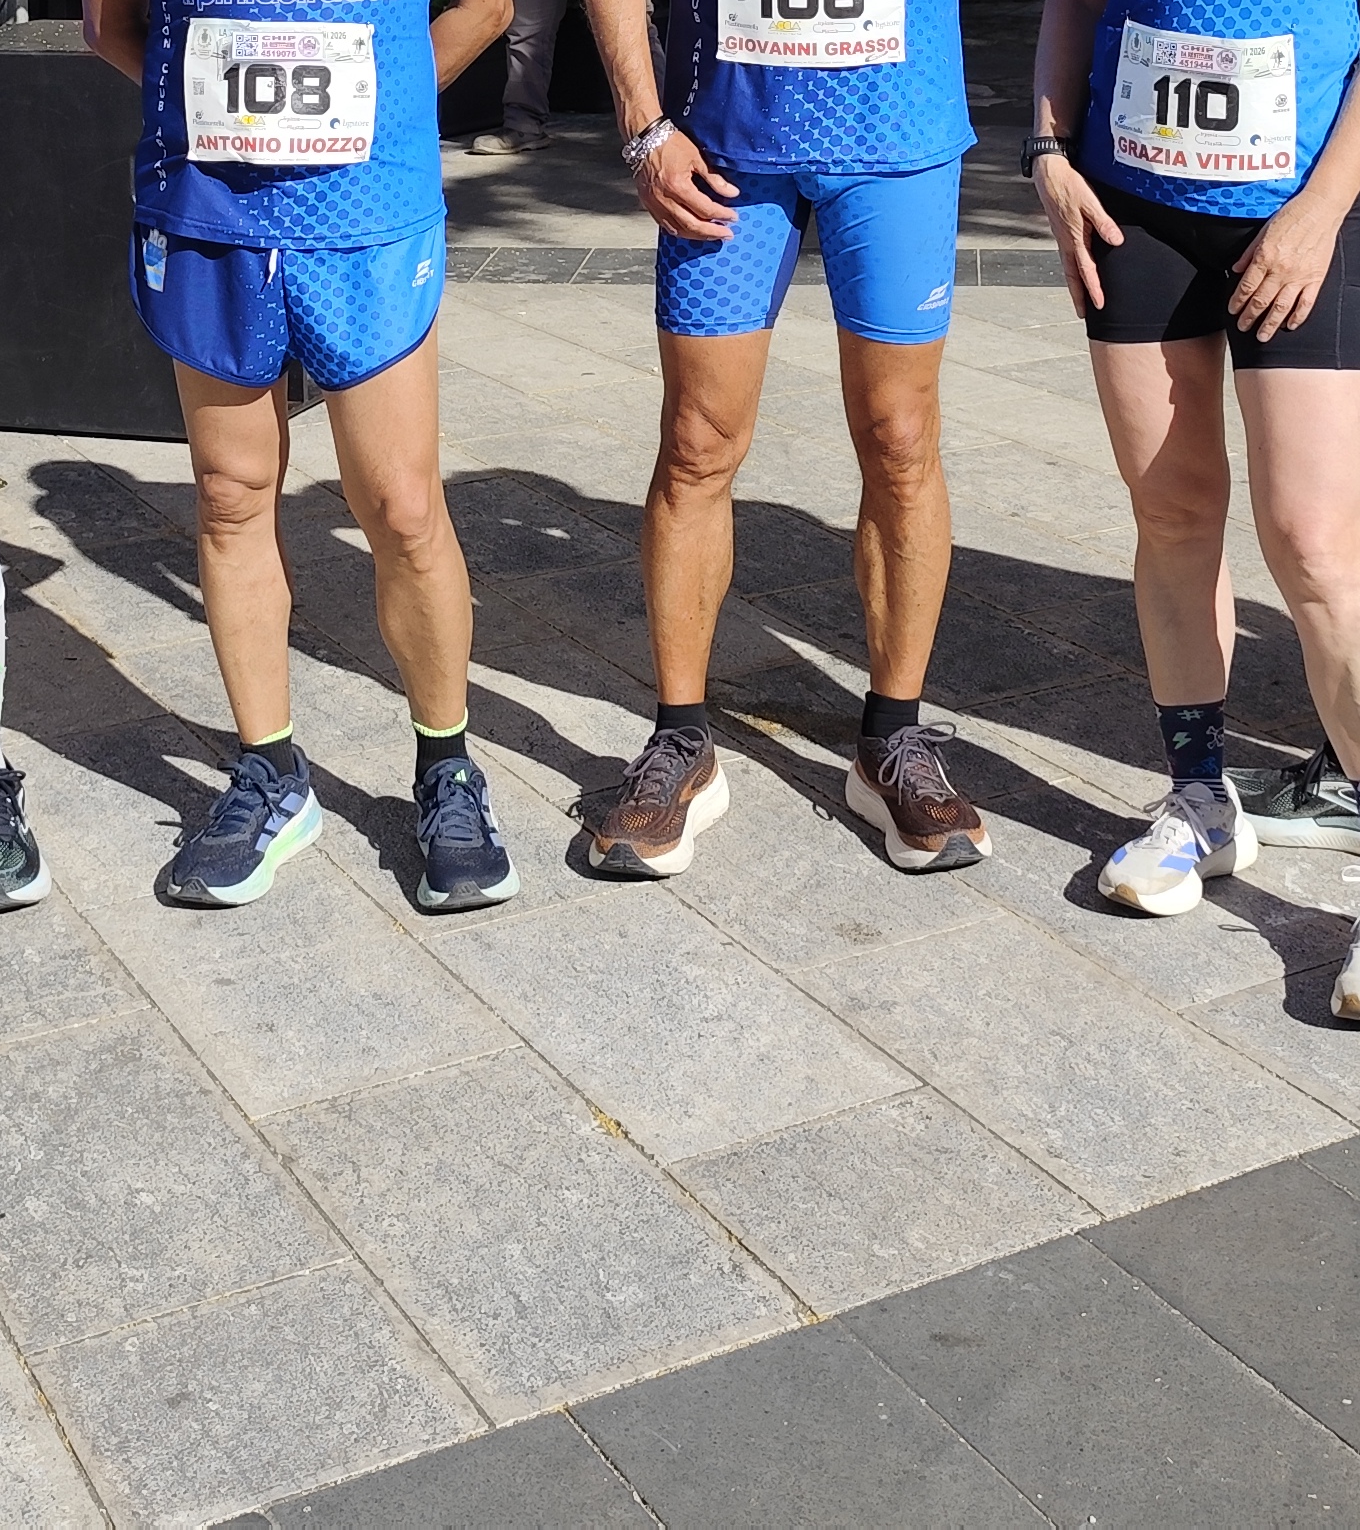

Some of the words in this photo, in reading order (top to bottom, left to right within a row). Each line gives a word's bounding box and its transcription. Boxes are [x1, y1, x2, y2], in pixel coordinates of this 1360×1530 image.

[330, 31, 347, 40] 2026
[725, 35, 818, 56] GIOVANNI
[825, 36, 900, 56] GRASSO
[1181, 44, 1216, 53] CHIP
[1249, 47, 1266, 56] 2026
[1179, 59, 1214, 70] 4519444
[683, 37, 702, 116] ARIANO
[158, 62, 169, 112] CLUB
[223, 62, 331, 115] 108
[1153, 74, 1240, 132] 110
[1151, 126, 1184, 139] ACCA
[196, 134, 281, 153] ANTONIO
[289, 137, 367, 154] IUOZZO
[1118, 136, 1188, 168] GRAZIA
[1196, 151, 1291, 171] VITILLO
